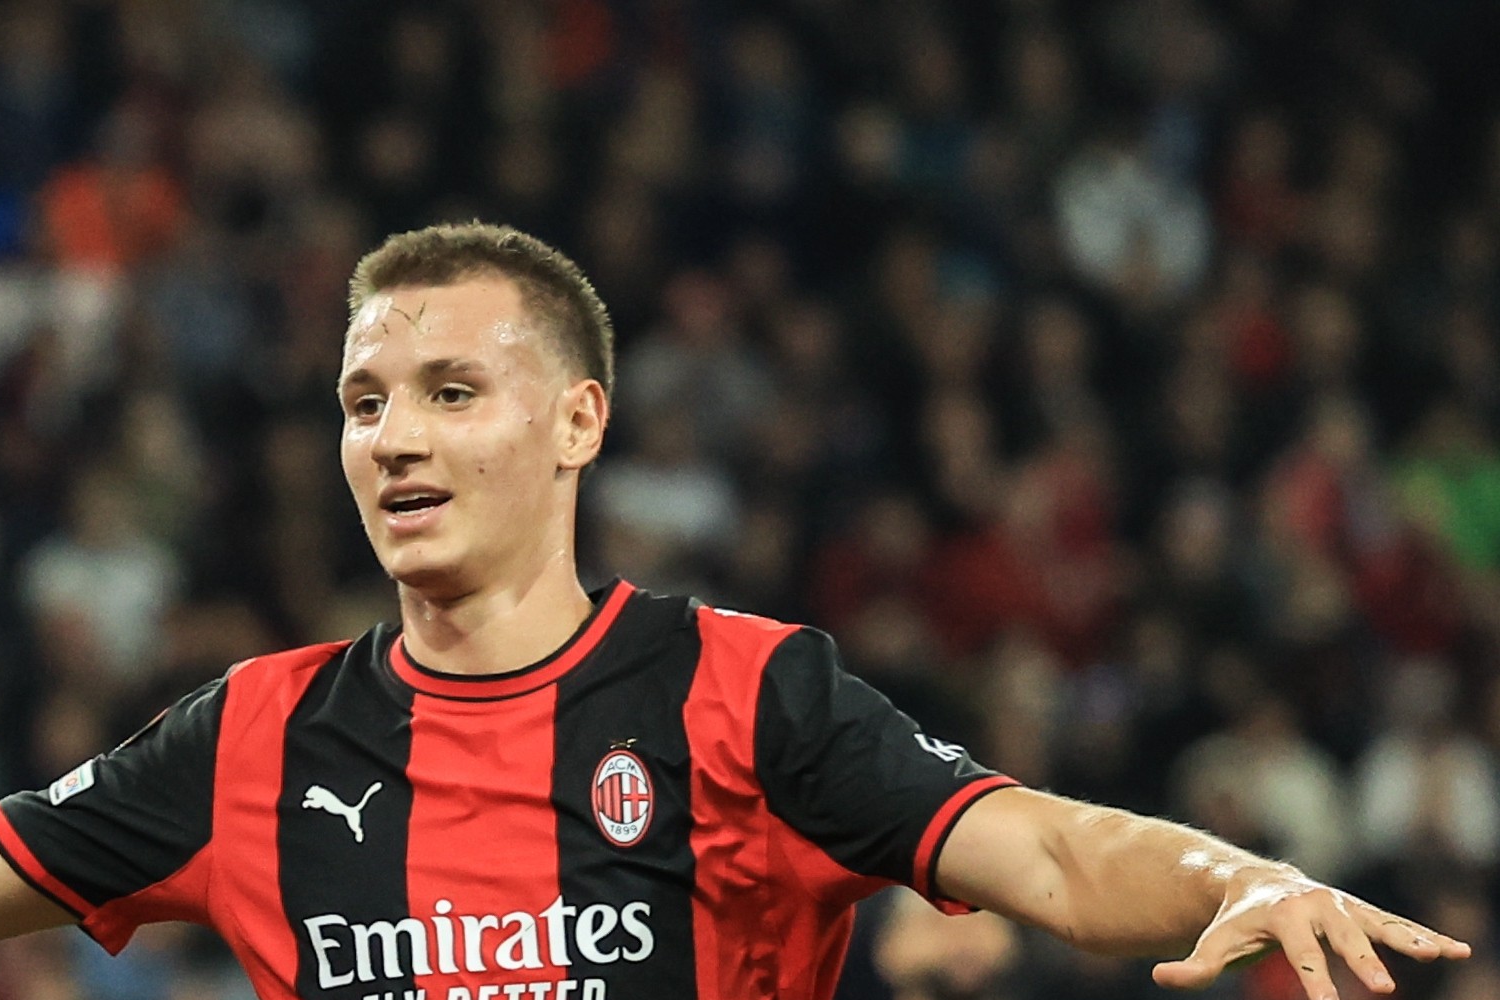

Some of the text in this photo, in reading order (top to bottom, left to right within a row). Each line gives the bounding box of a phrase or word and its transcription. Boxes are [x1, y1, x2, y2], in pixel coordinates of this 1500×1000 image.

[605, 758, 638, 775] ACM
[610, 824, 638, 835] 1899
[303, 895, 654, 989] Emirates
